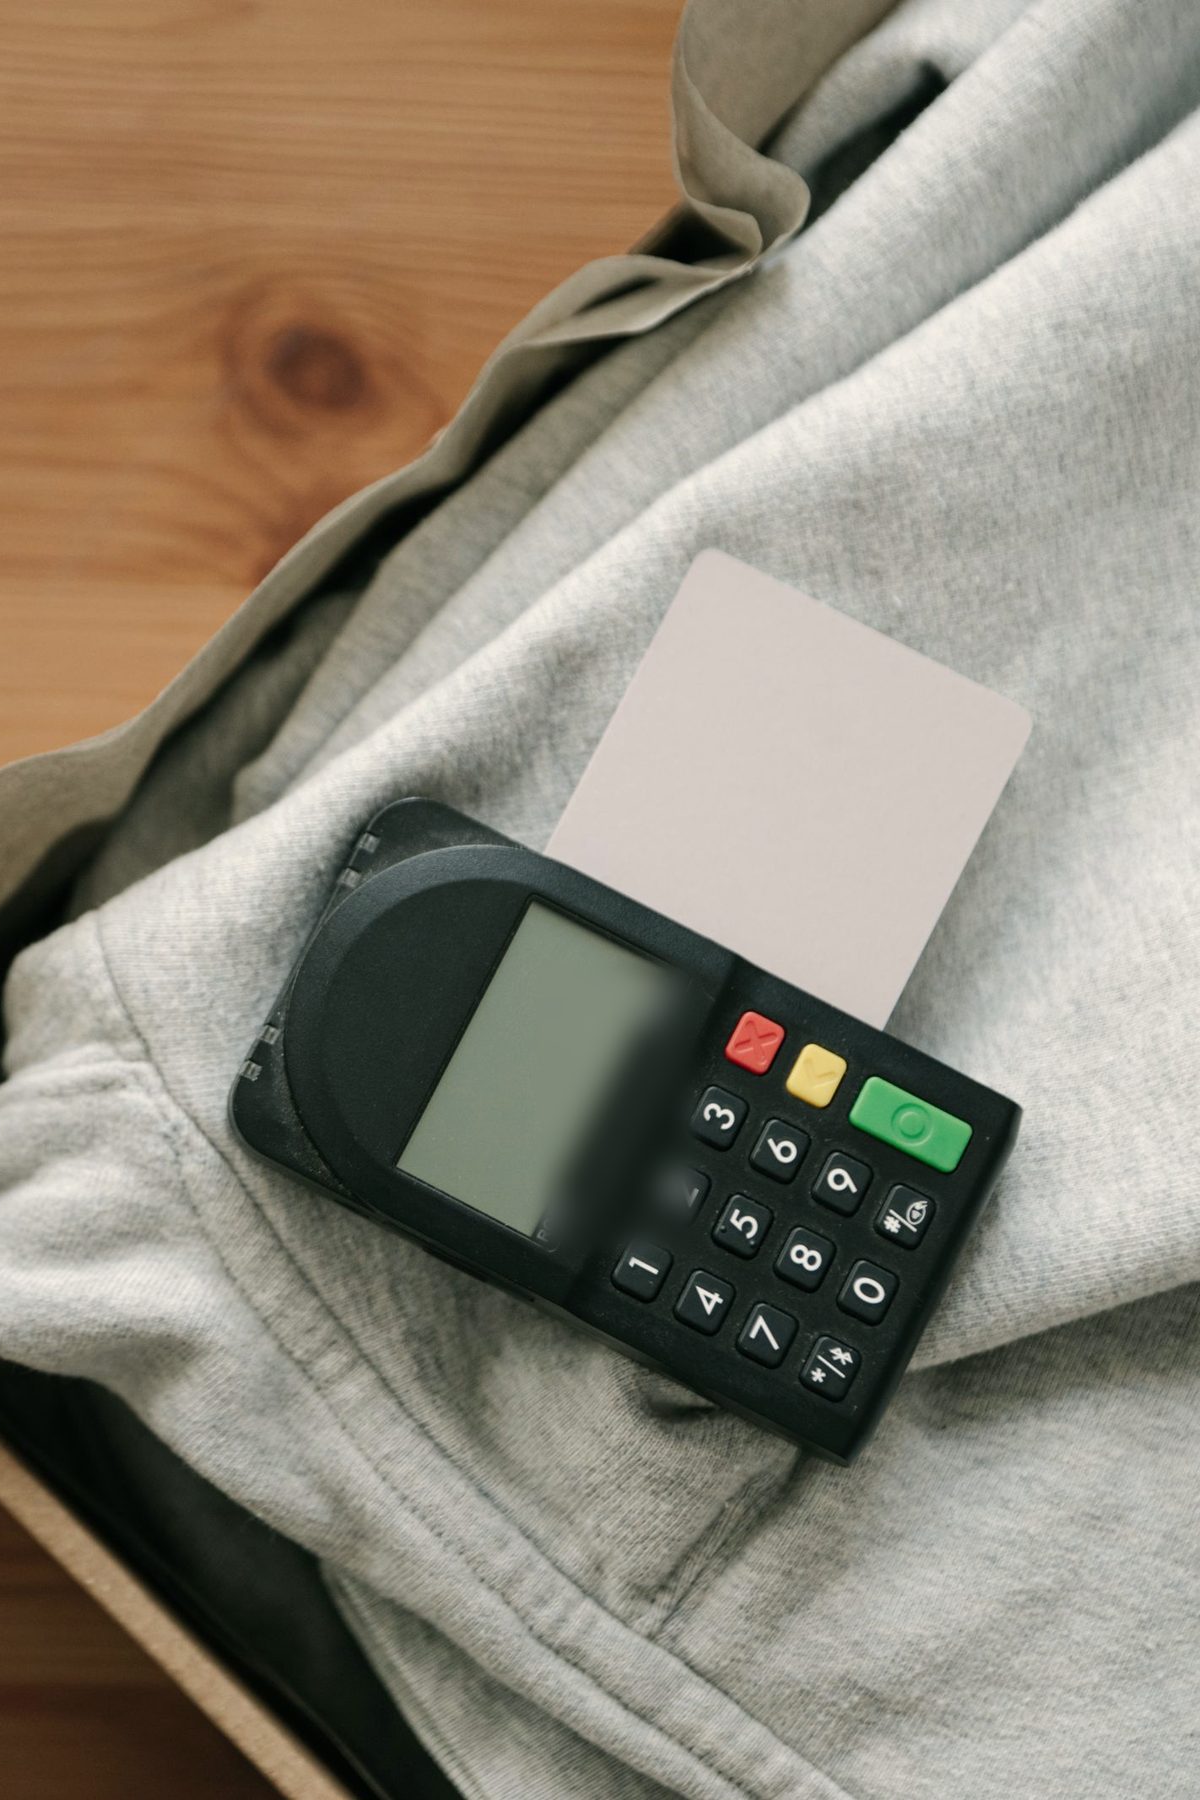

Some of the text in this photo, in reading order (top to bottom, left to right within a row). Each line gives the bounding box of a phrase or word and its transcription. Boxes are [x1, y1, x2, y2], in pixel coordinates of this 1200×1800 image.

[703, 1102, 736, 1130] 3
[767, 1137, 798, 1164] 6
[826, 1167, 858, 1194] 9
[729, 1208, 759, 1240] 5
[628, 1256, 659, 1275] 1
[790, 1243, 823, 1272] 8
[695, 1285, 724, 1316] 4
[749, 1314, 780, 1351] 7
